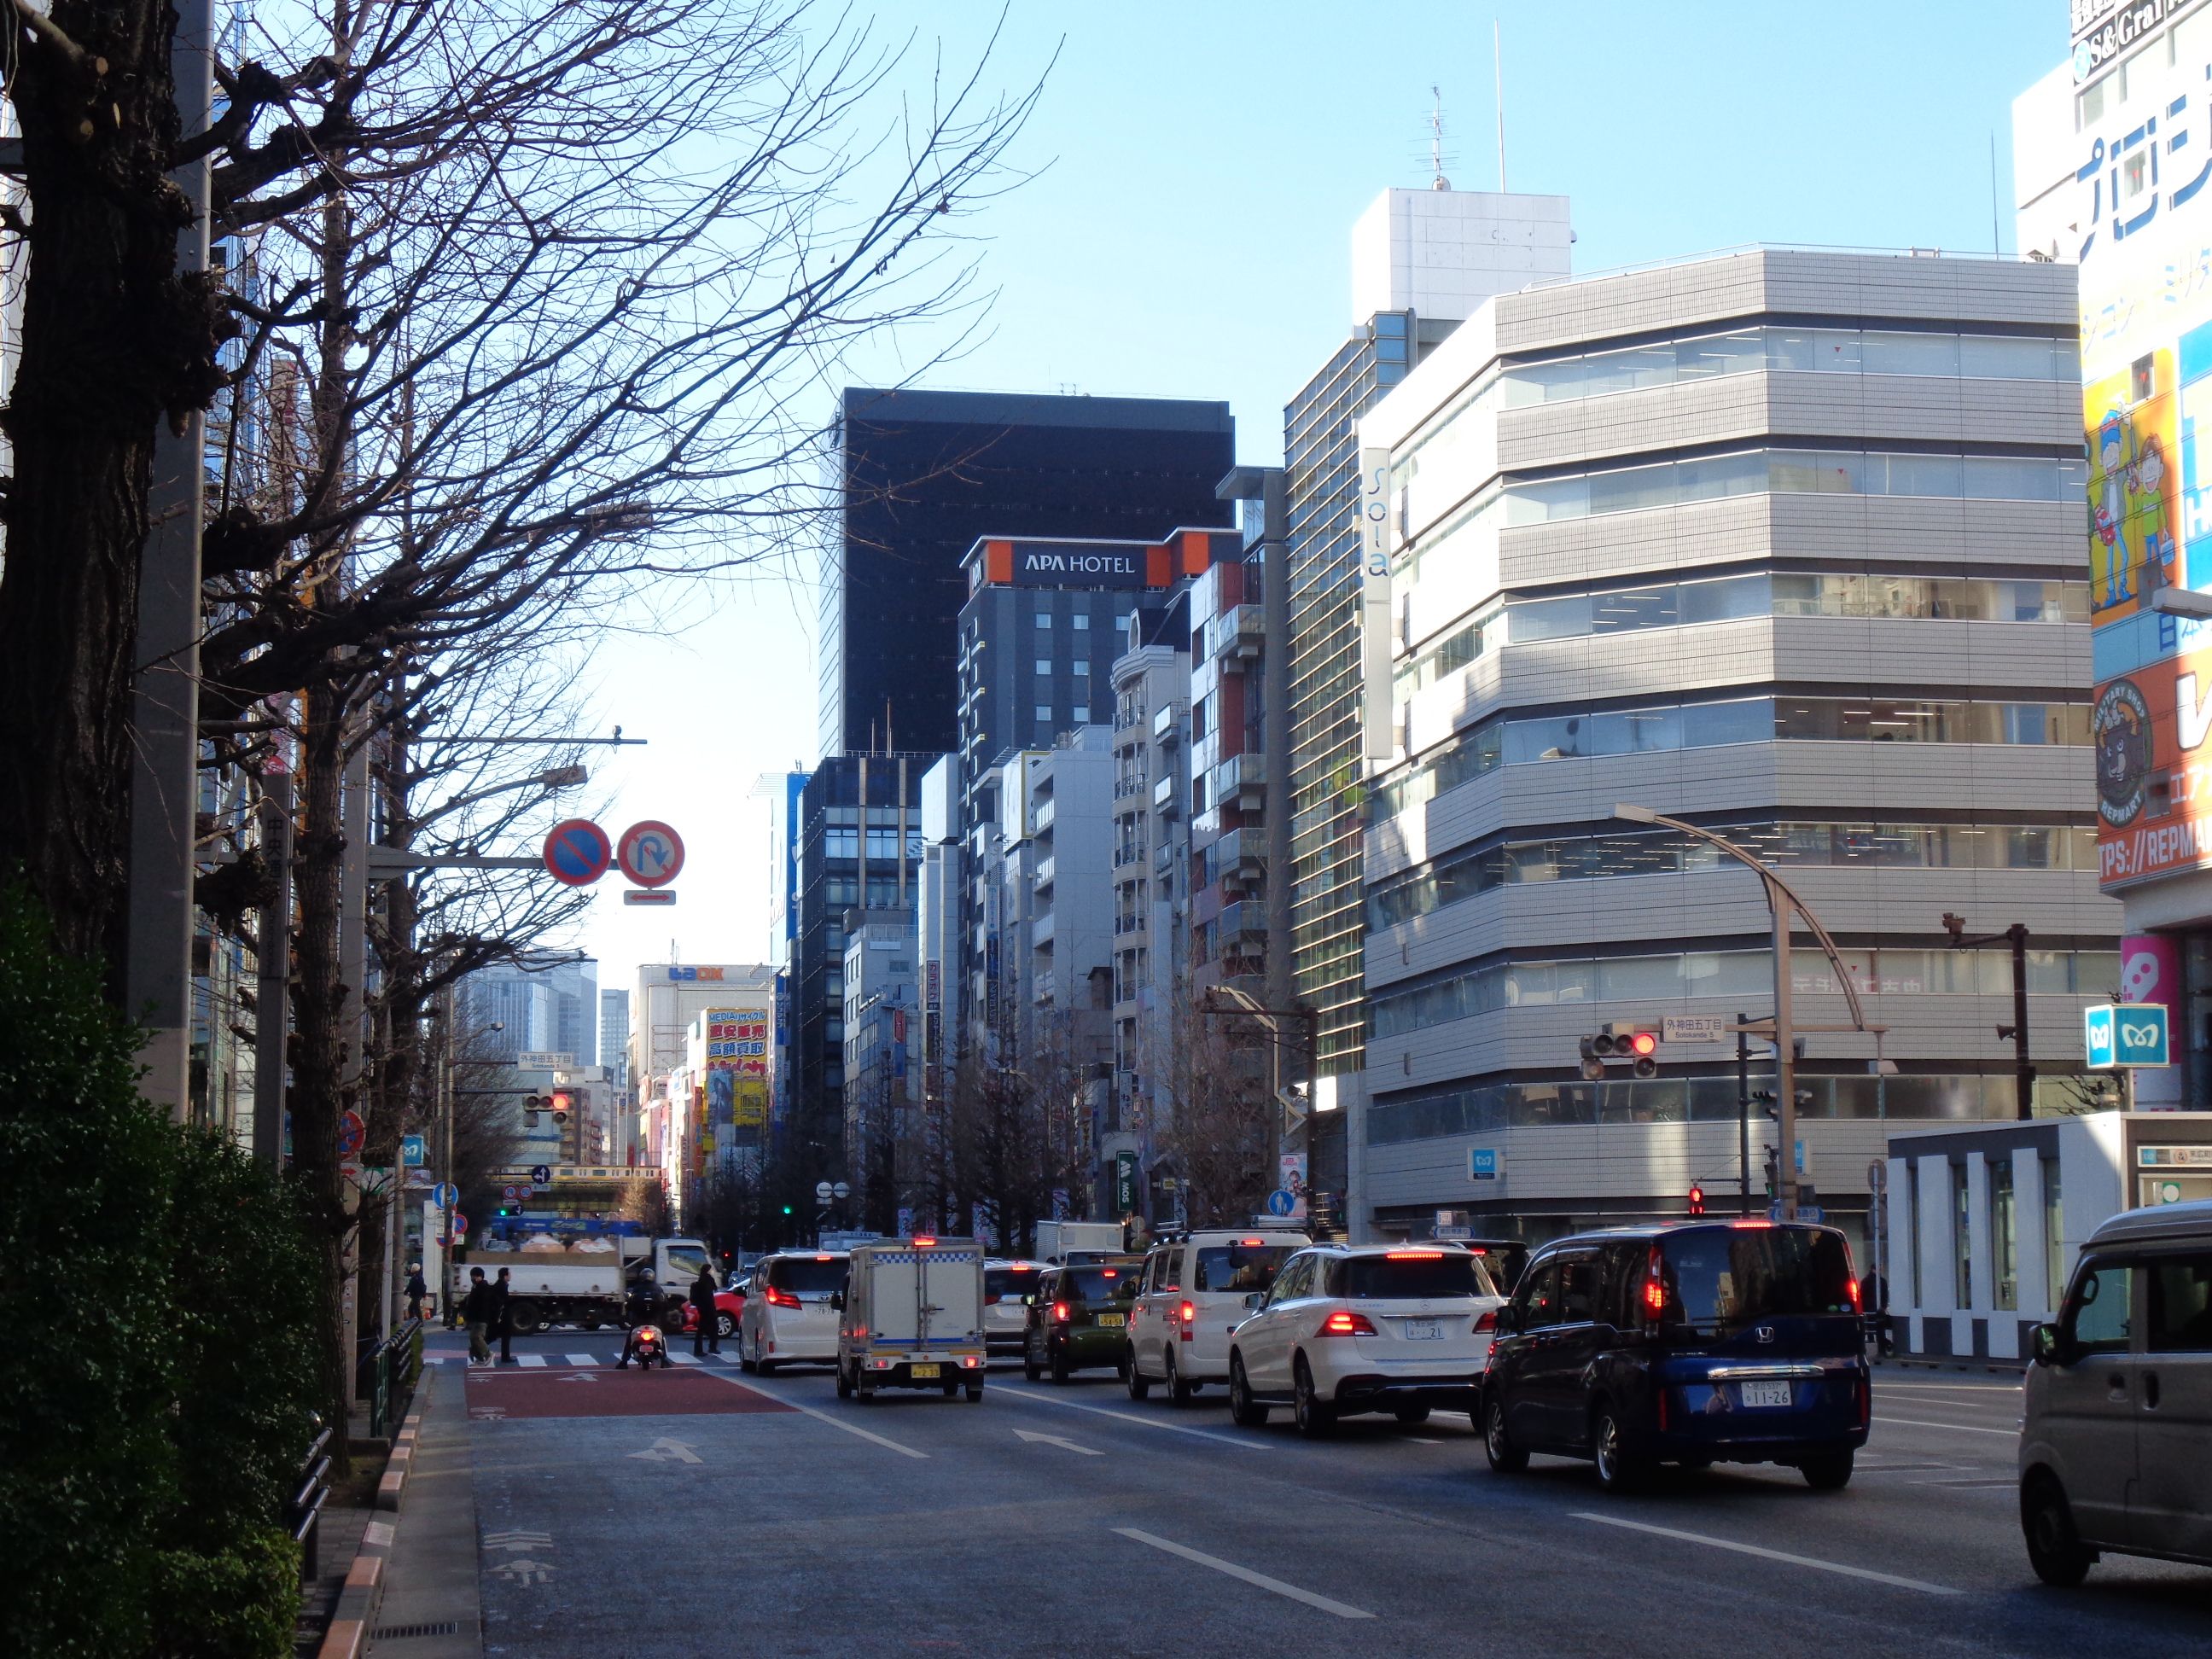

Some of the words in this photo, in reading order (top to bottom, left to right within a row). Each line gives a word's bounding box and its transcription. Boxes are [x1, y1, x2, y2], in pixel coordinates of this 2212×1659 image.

[1025, 555, 1065, 573] APA
[1069, 556, 1136, 574] HOTEL
[2127, 689, 2145, 719] SHOP
[2100, 789, 2141, 823] REPMART
[928, 962, 938, 999] カラオケ
[1667, 1018, 1721, 1031] 外神田五丁目
[708, 1040, 765, 1058] 高額買取
[520, 1054, 571, 1063] 外神田五丁目
[1754, 1391, 1789, 1405] 11-26
